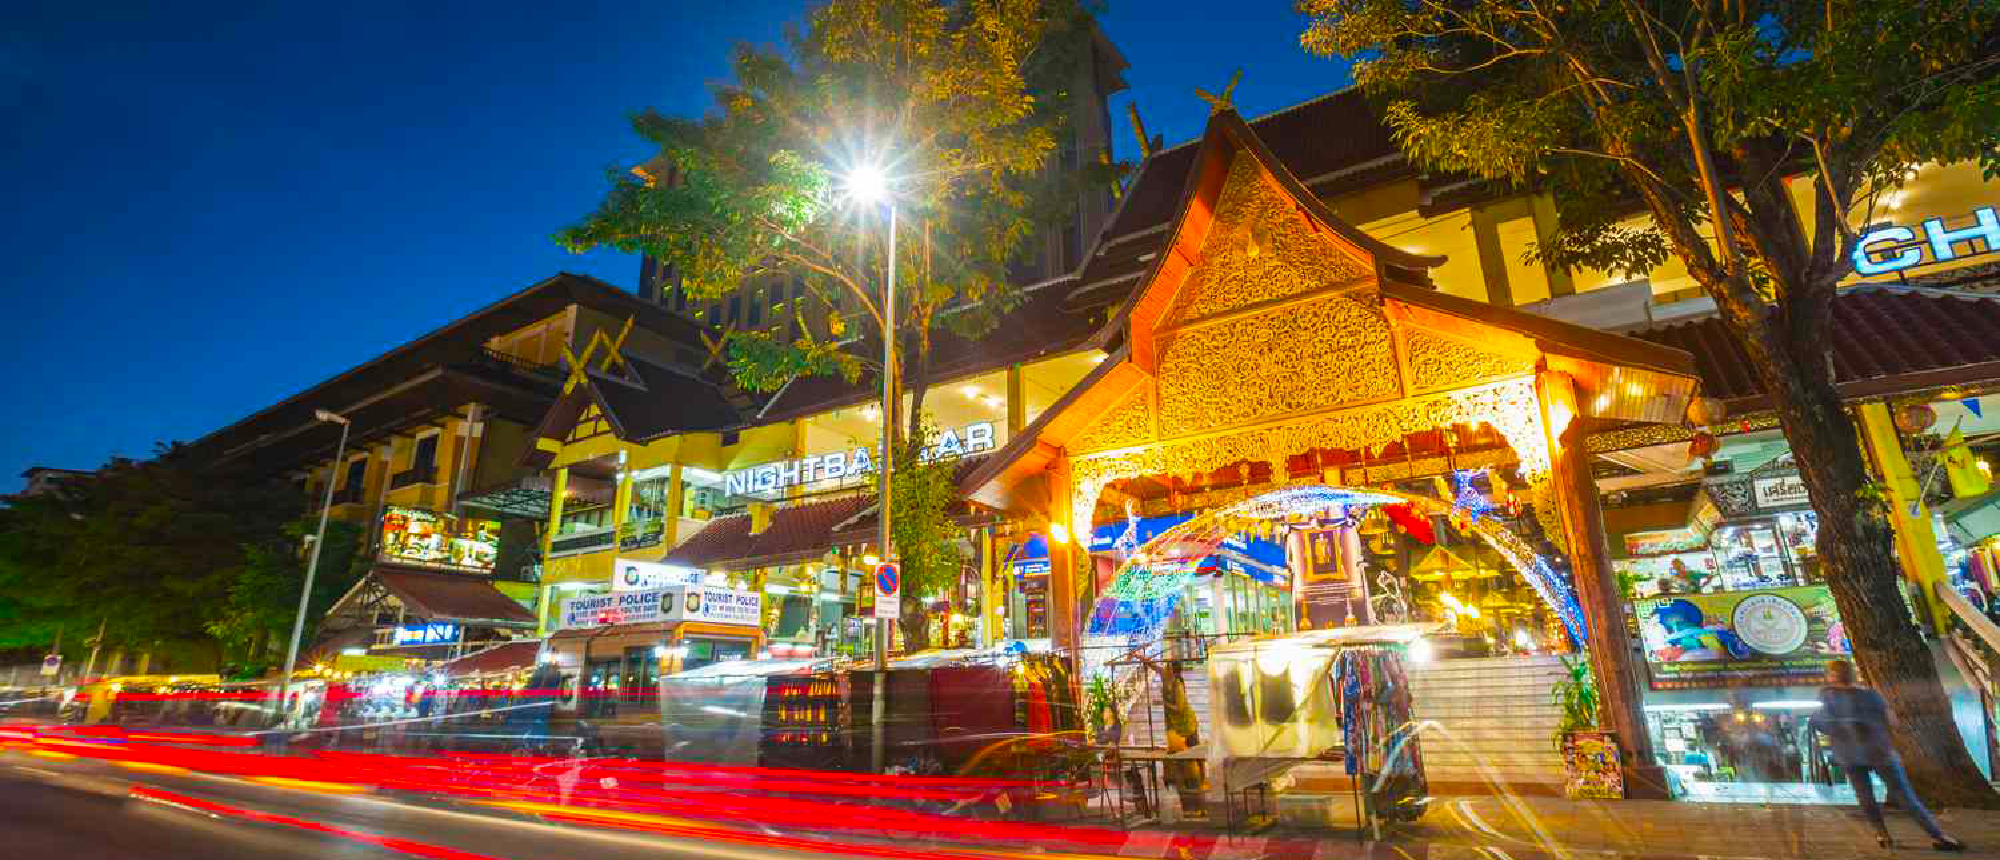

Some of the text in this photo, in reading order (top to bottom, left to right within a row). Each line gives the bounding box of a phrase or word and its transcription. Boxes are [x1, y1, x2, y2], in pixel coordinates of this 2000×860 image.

[570, 592, 661, 611] TOURIST POLICE
[704, 592, 758, 607] TOURIST POLICE
